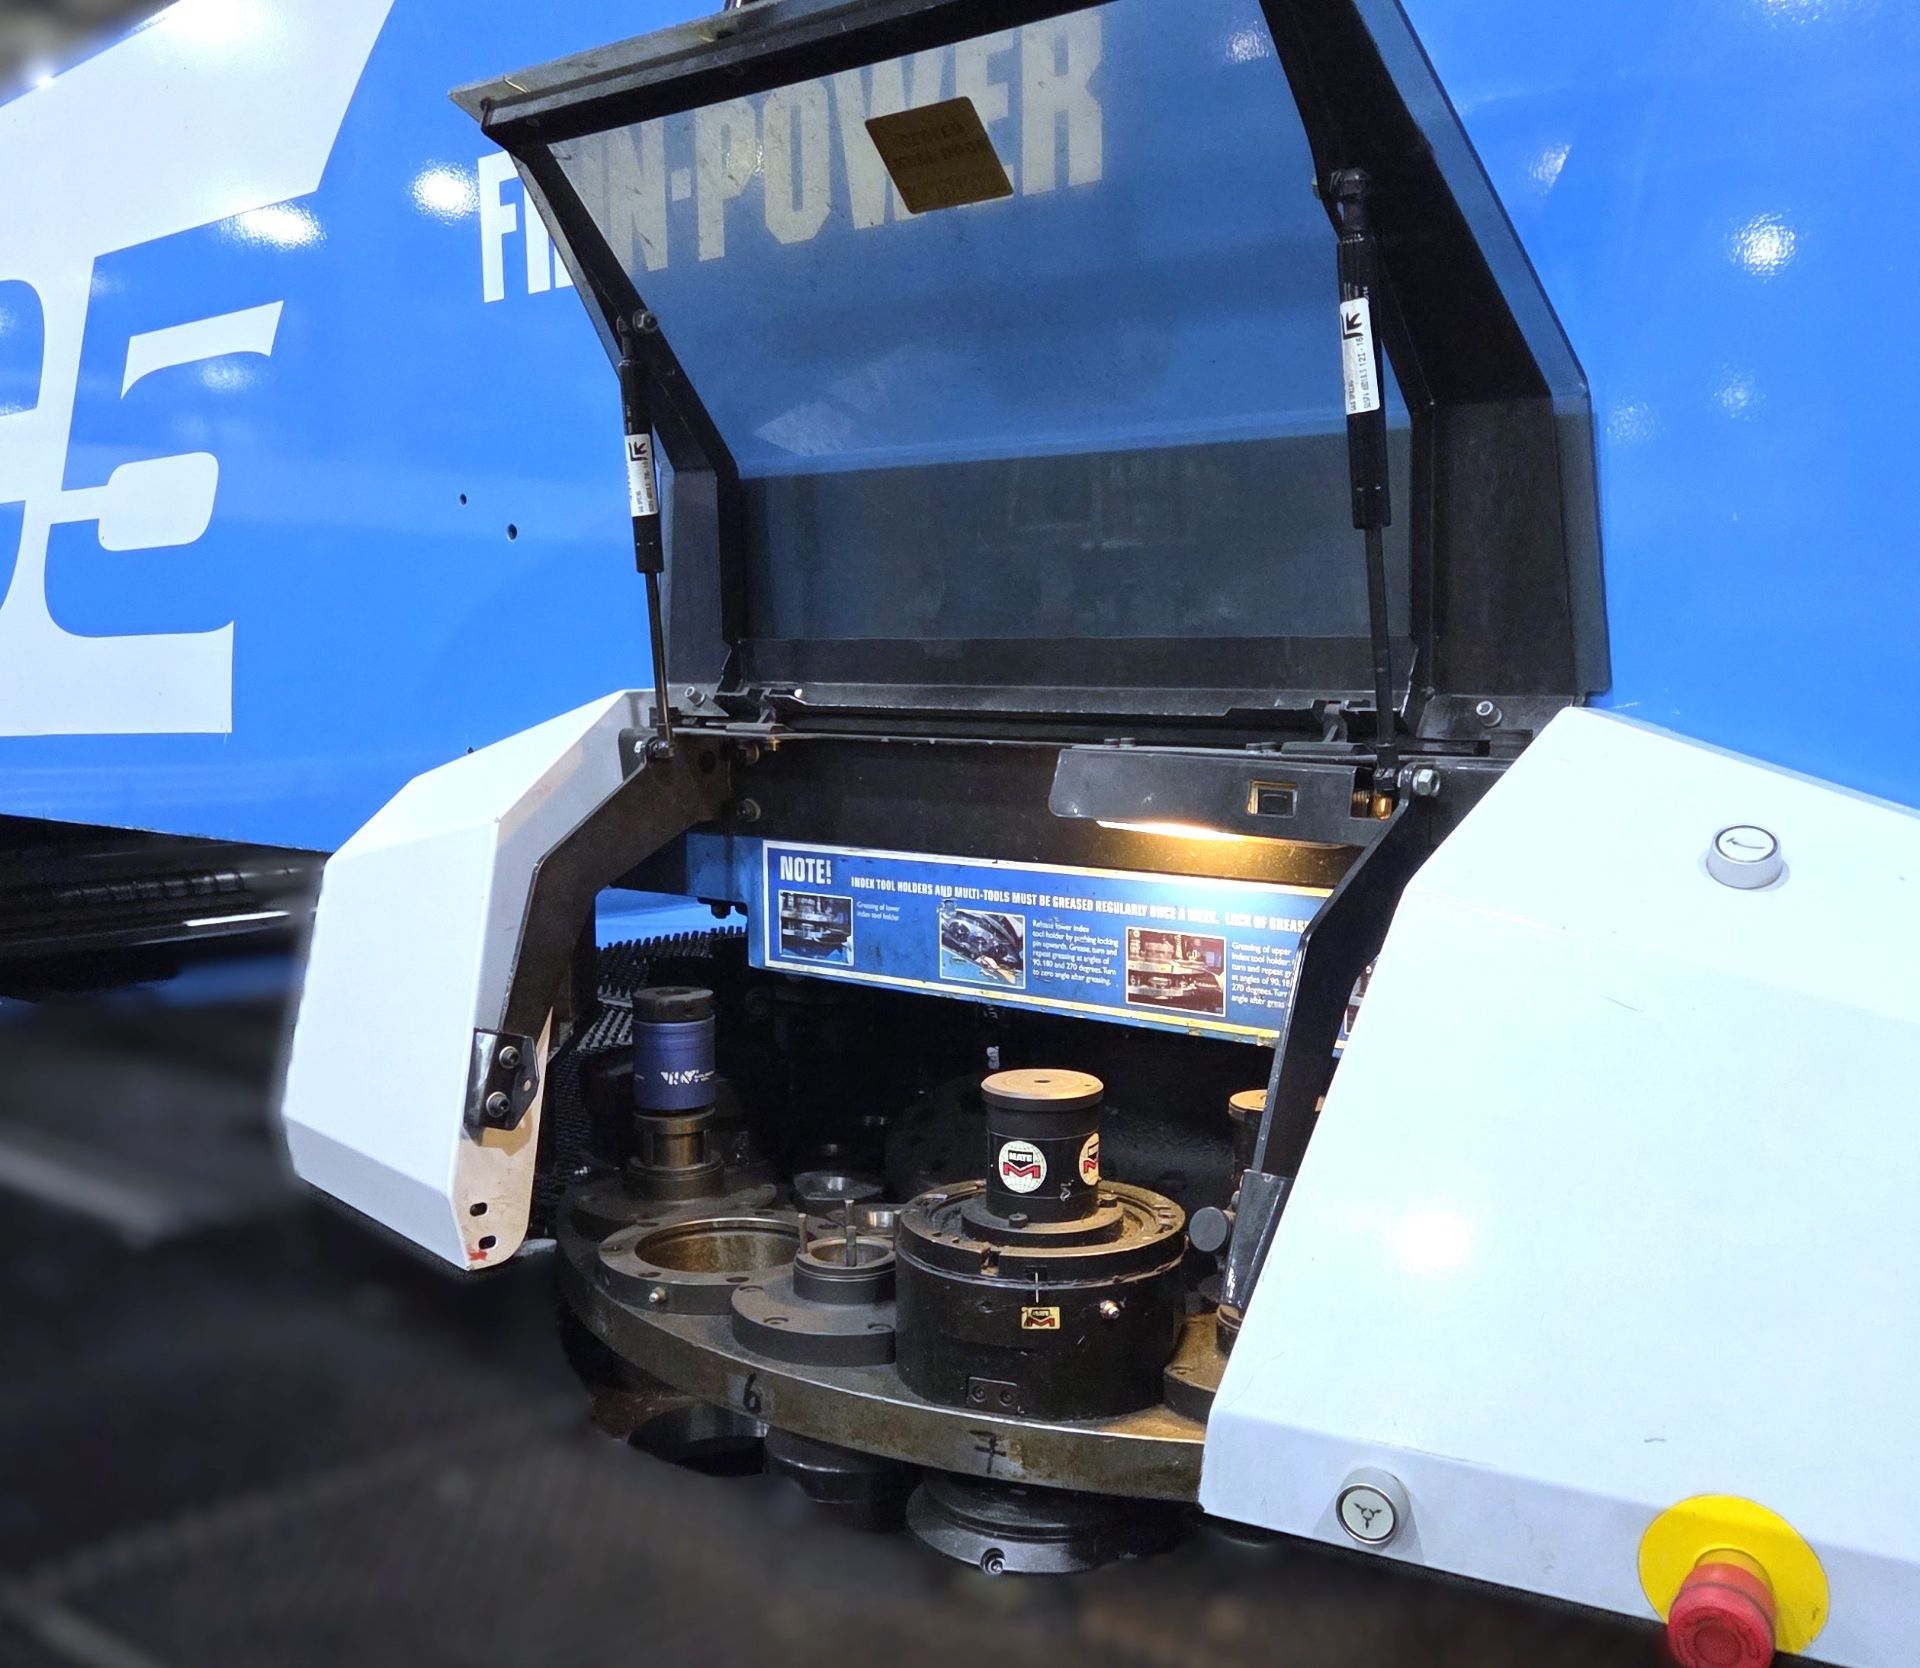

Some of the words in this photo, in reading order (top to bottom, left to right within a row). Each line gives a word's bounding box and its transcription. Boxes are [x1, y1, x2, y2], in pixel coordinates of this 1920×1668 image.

[780, 856, 832, 884] NOTE!
[851, 876, 874, 890] INDEX
[876, 879, 896, 892] TOOL
[897, 880, 933, 896] HOLDERS
[935, 884, 952, 898] AND
[954, 887, 1010, 903] MULTI-TOOLS
[1012, 892, 1038, 906] MUST
[1039, 895, 1050, 907] BE
[1052, 897, 1093, 912] GREASED
[1096, 901, 1147, 917] REGULARLY
[1178, 906, 1186, 921] A
[1254, 914, 1266, 928] OF
[1269, 916, 1310, 933] GREAS
[1046, 931, 1064, 940] holder
[1065, 933, 1073, 942] by
[1074, 936, 1096, 945] pushing
[1097, 937, 1118, 948] locking
[1232, 941, 1261, 954] Greasing
[1262, 945, 1270, 953] of
[1272, 948, 1292, 956] upper
[1032, 950, 1051, 958] repeat
[1052, 953, 1075, 962] greasing
[1084, 956, 1101, 965] angles
[1103, 967, 1116, 975] Turn
[1261, 967, 1284, 976] repeat
[1240, 975, 1260, 984] angles
[1232, 984, 1244, 992] 270
[1232, 995, 1248, 1004] angle
[743, 1373, 762, 1414] 6
[969, 1430, 1007, 1474] 7
